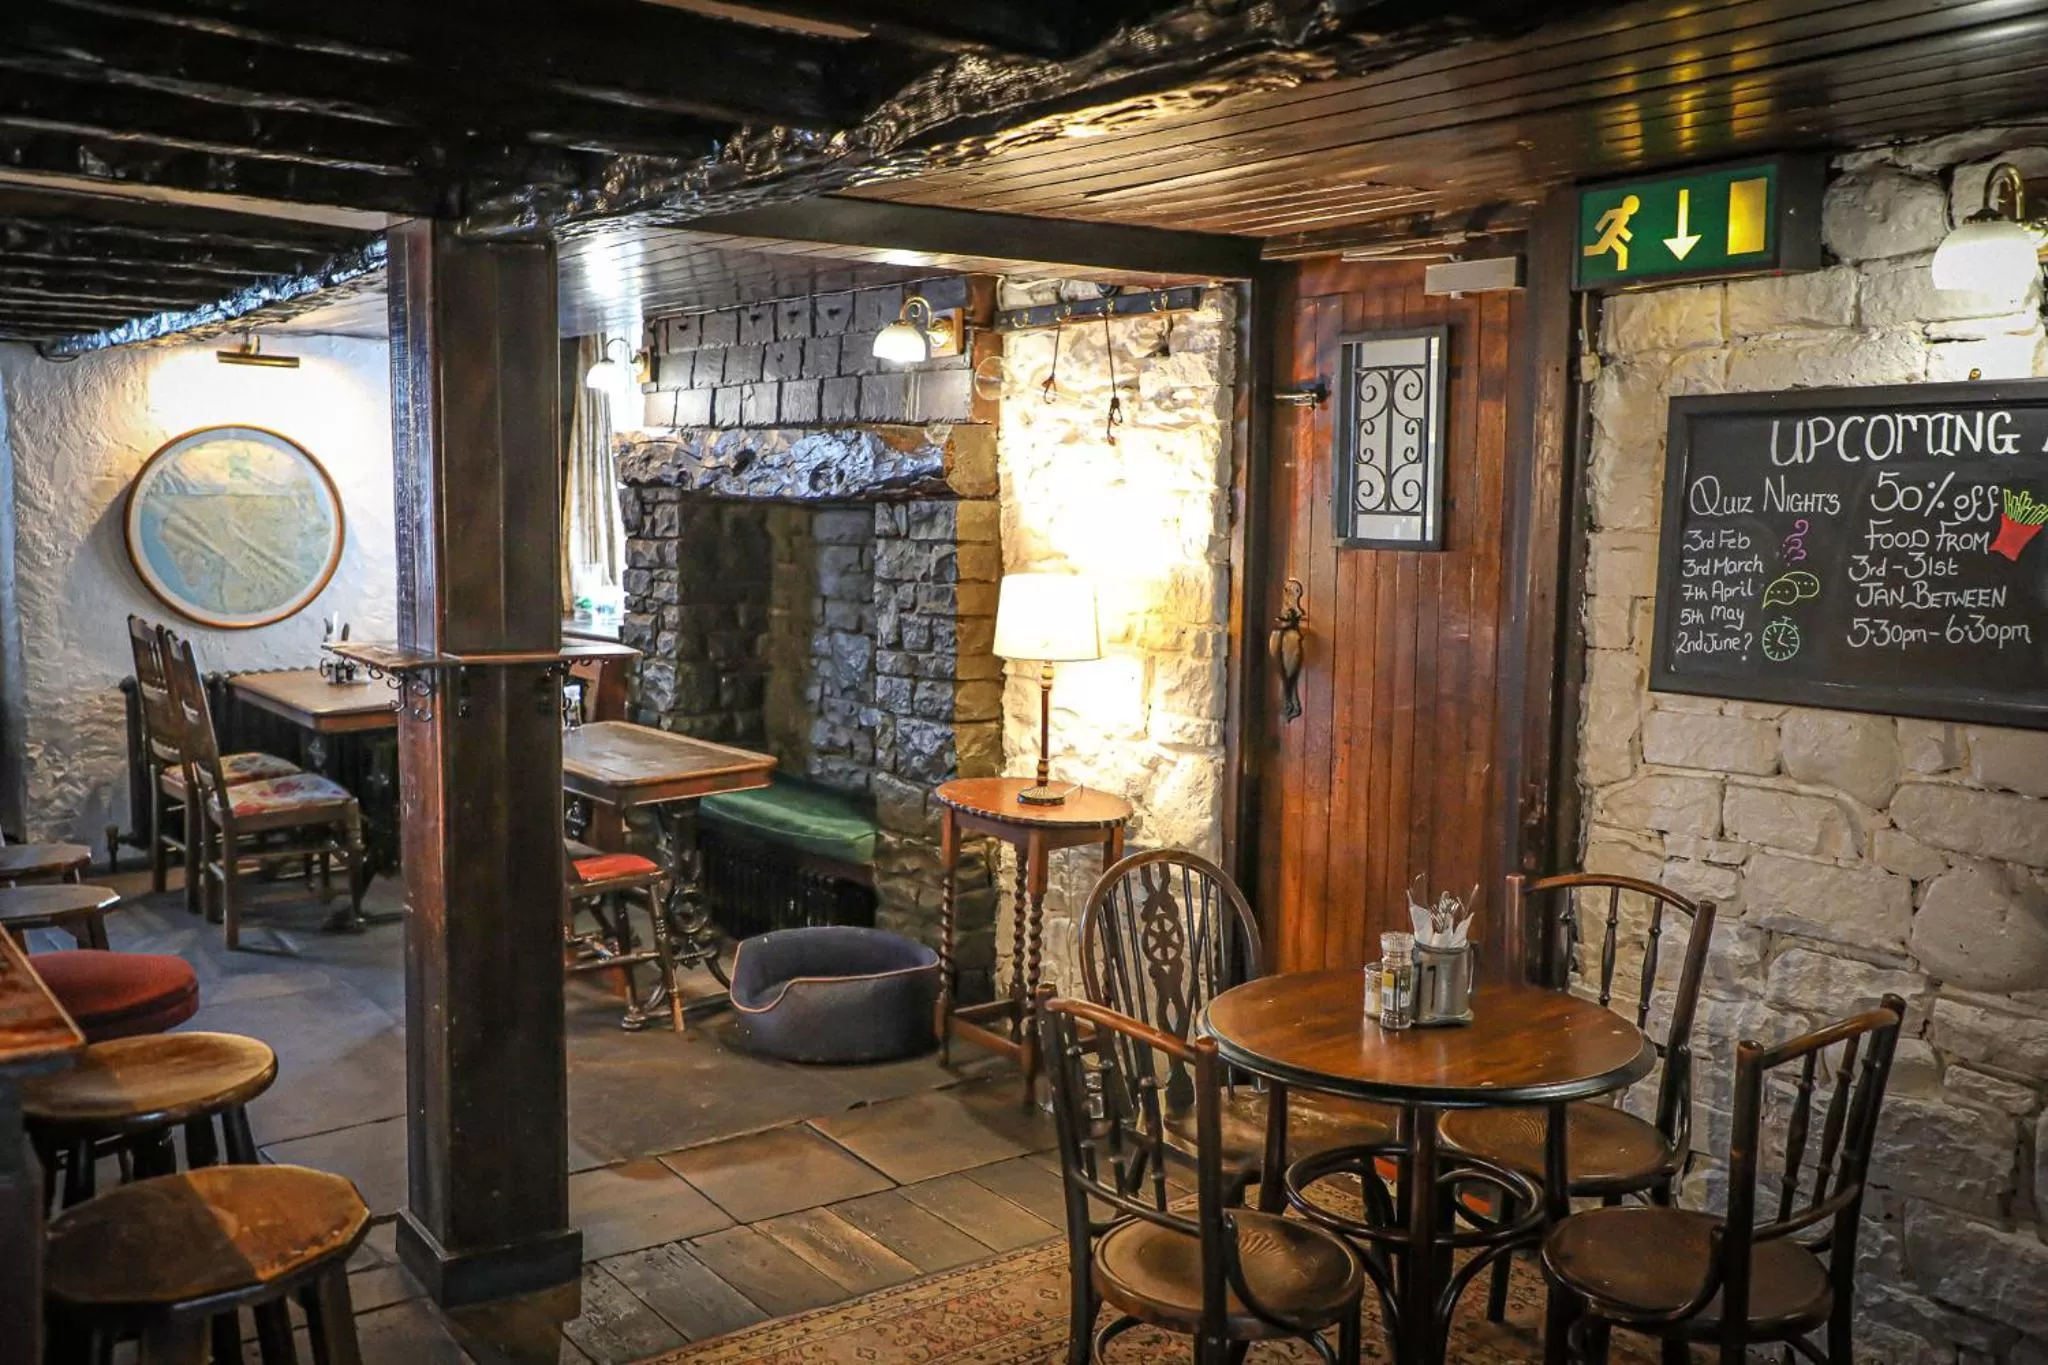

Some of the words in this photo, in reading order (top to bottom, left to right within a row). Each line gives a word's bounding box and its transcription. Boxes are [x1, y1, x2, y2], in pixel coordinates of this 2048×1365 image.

[1770, 410, 2021, 467] UPCOMING
[1870, 471, 1956, 517] 50%
[1953, 485, 1999, 522] off
[1682, 529, 1715, 551] 3rd
[1718, 529, 1751, 549] Feb
[1681, 558, 1710, 577] 3rd
[1713, 553, 1765, 577] March
[1848, 555, 1888, 581] 3rd
[1681, 584, 1709, 601] 7th
[1711, 578, 1754, 602] April
[1679, 608, 1705, 626] 5th
[1675, 629, 1703, 655] 2nd
